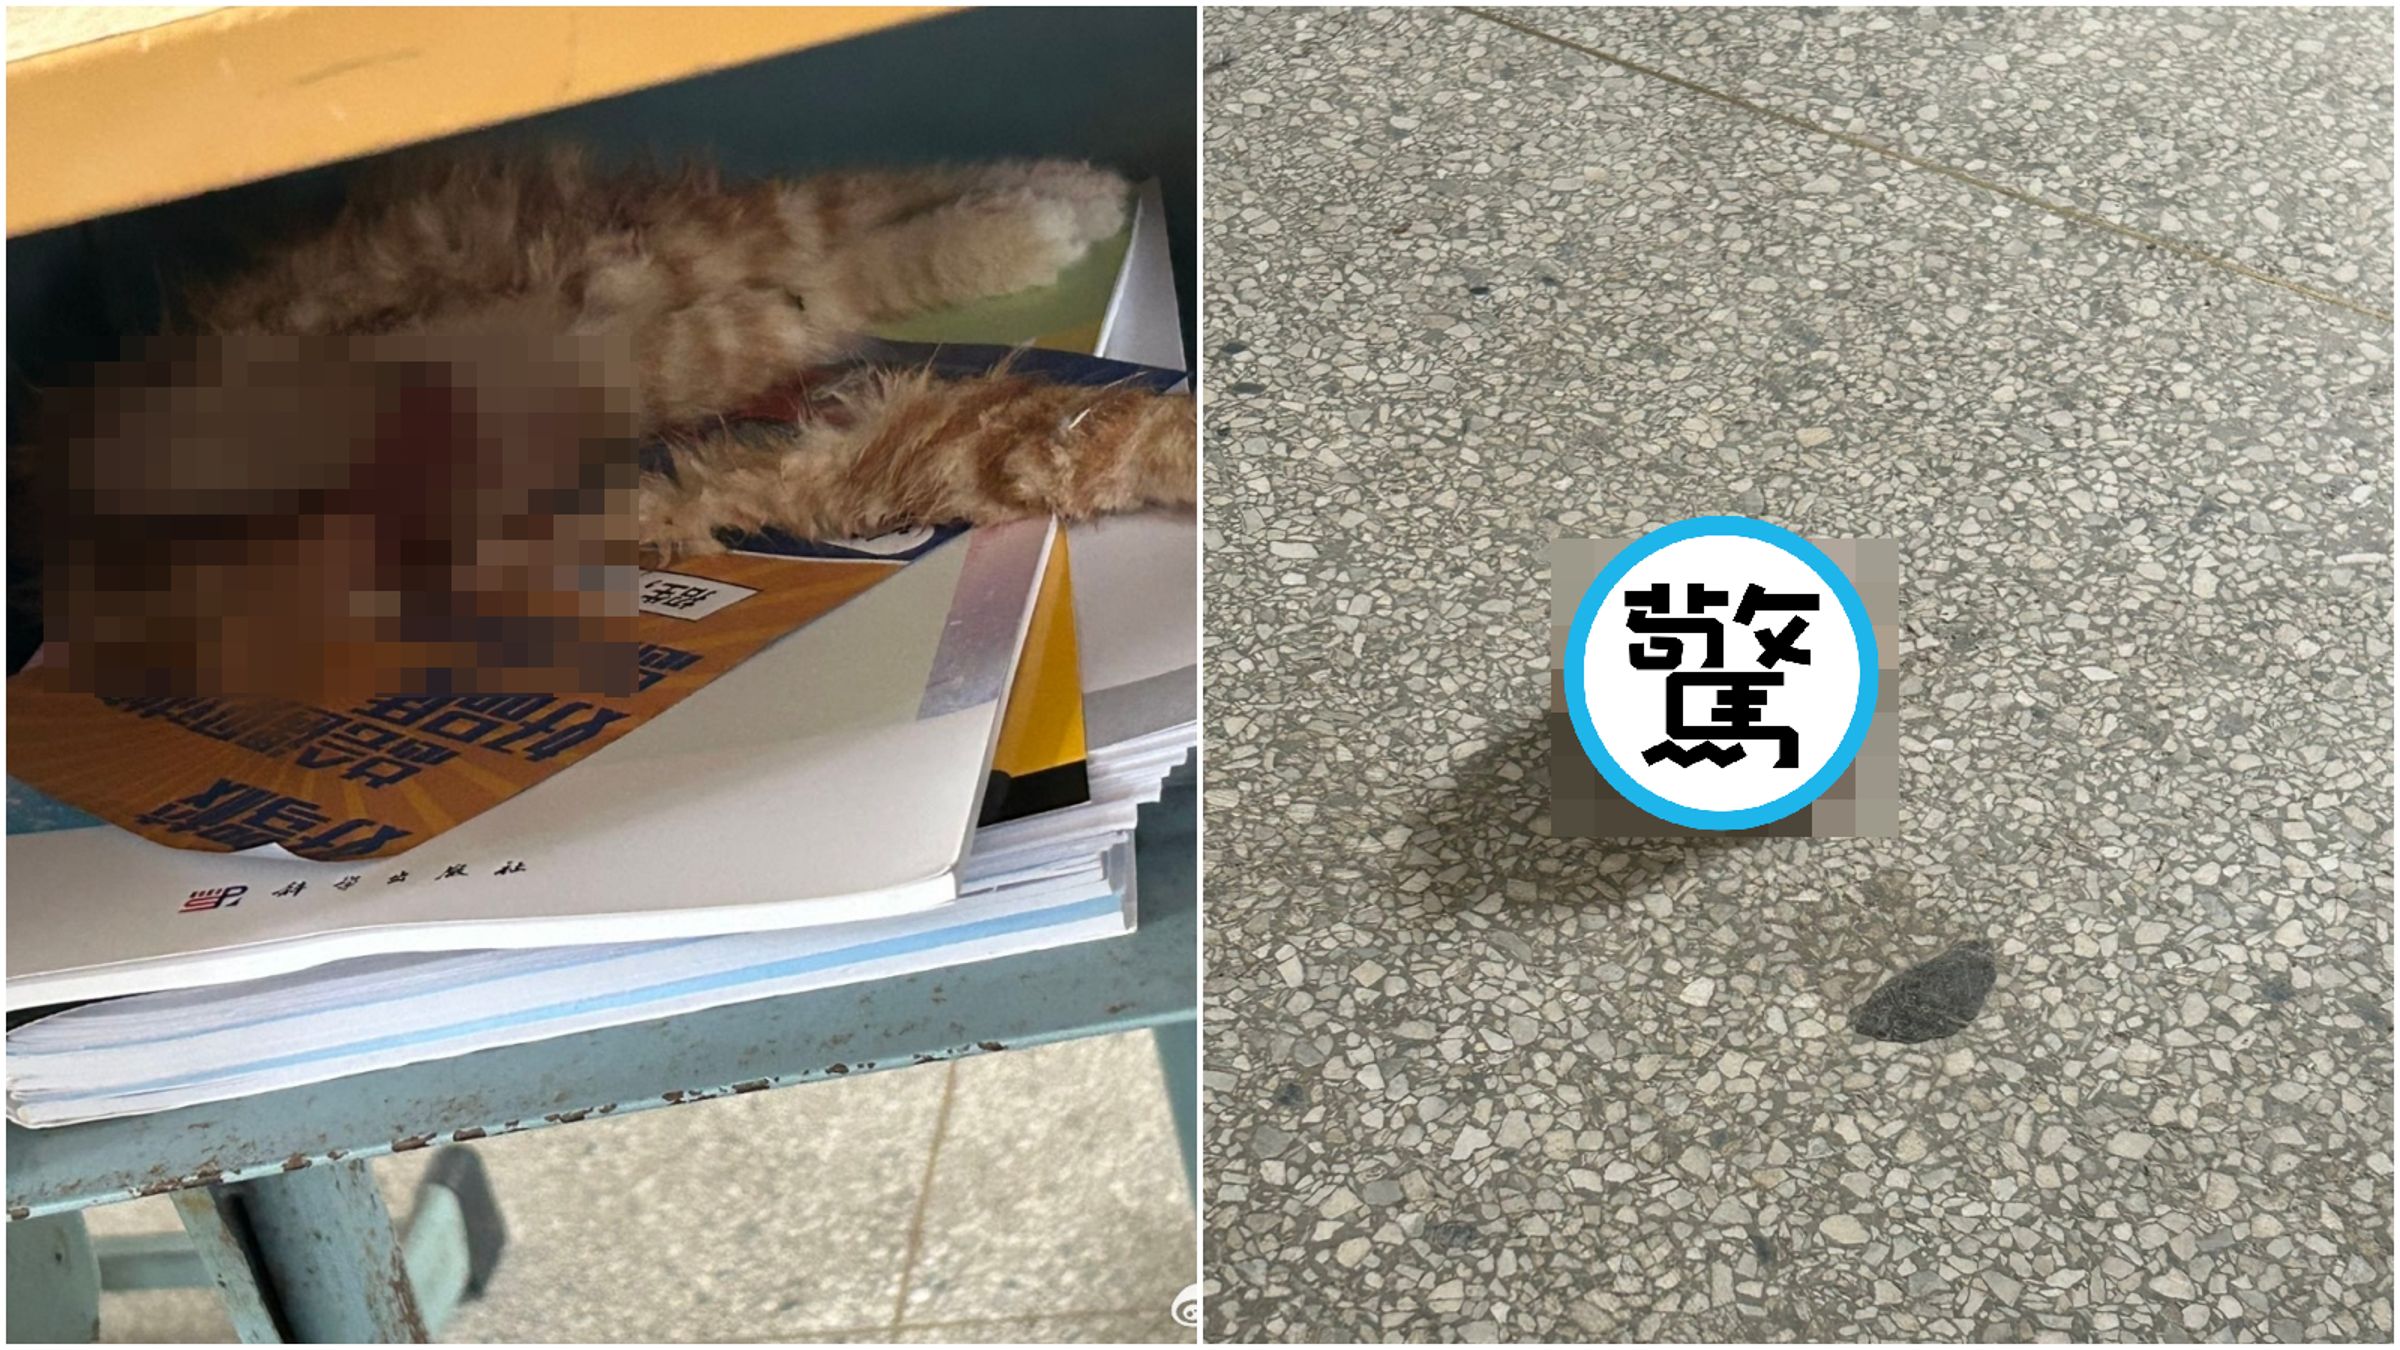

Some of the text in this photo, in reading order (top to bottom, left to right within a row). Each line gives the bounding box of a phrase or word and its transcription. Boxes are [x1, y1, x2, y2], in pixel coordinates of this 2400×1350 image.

[272, 861, 526, 897] 科学出版社
